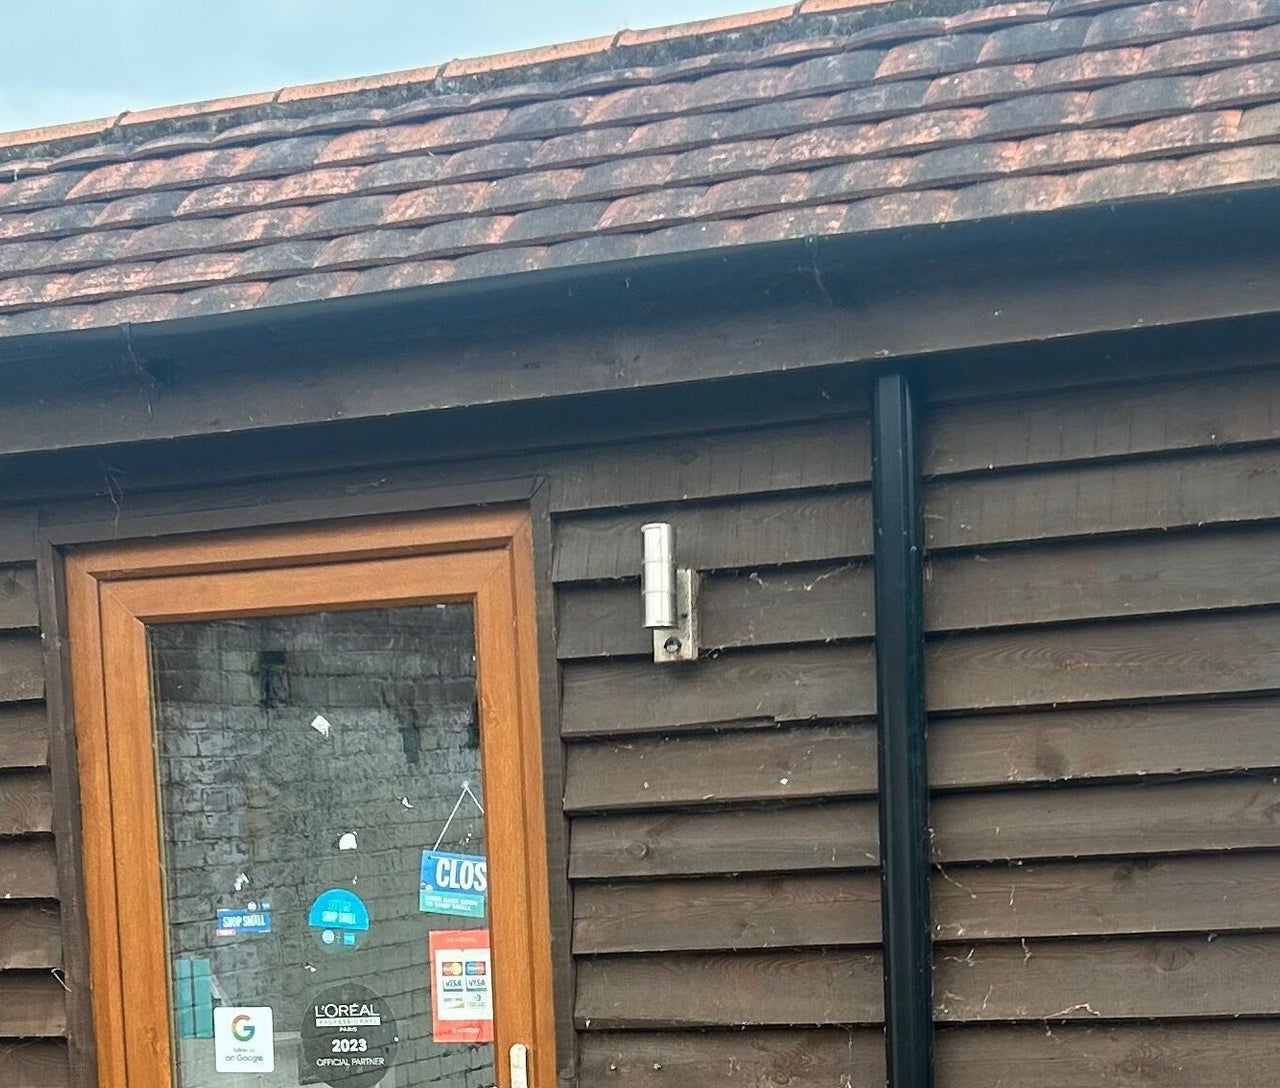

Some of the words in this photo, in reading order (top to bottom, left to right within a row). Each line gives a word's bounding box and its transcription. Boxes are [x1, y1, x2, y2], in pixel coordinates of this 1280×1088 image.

[222, 915, 242, 928] SHOP
[242, 914, 266, 927] SMALL
[314, 1003, 380, 1018] L'ORÉAL
[331, 1038, 368, 1053] 2023
[316, 1058, 351, 1067] OFFICIAL
[351, 1057, 385, 1066] PARTNER
